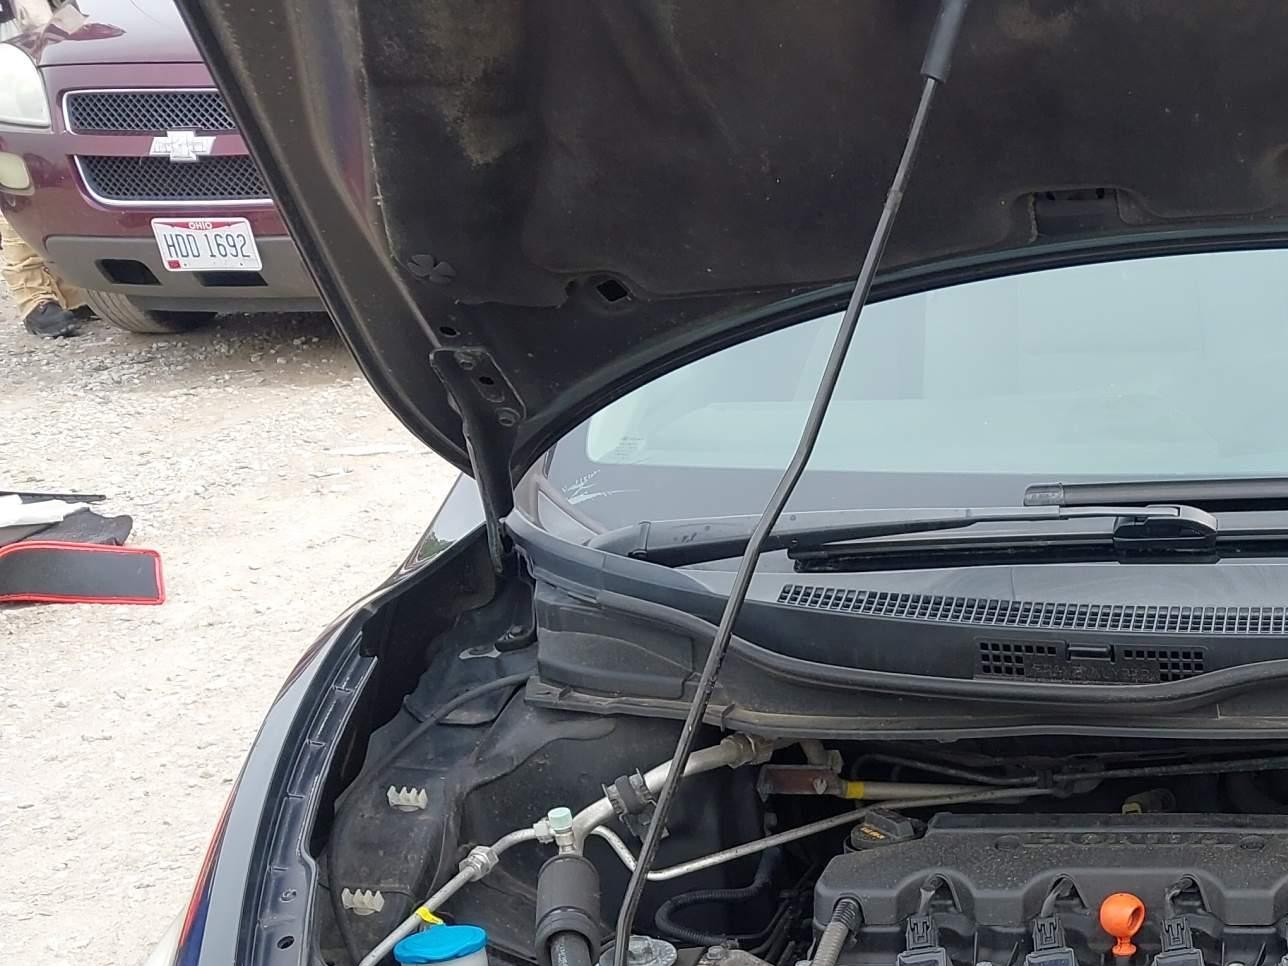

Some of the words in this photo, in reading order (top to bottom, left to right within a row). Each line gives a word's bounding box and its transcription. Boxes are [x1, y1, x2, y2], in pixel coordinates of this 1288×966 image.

[188, 221, 213, 231] OHIO
[163, 233, 201, 258] HDD
[204, 233, 251, 258] 1692
